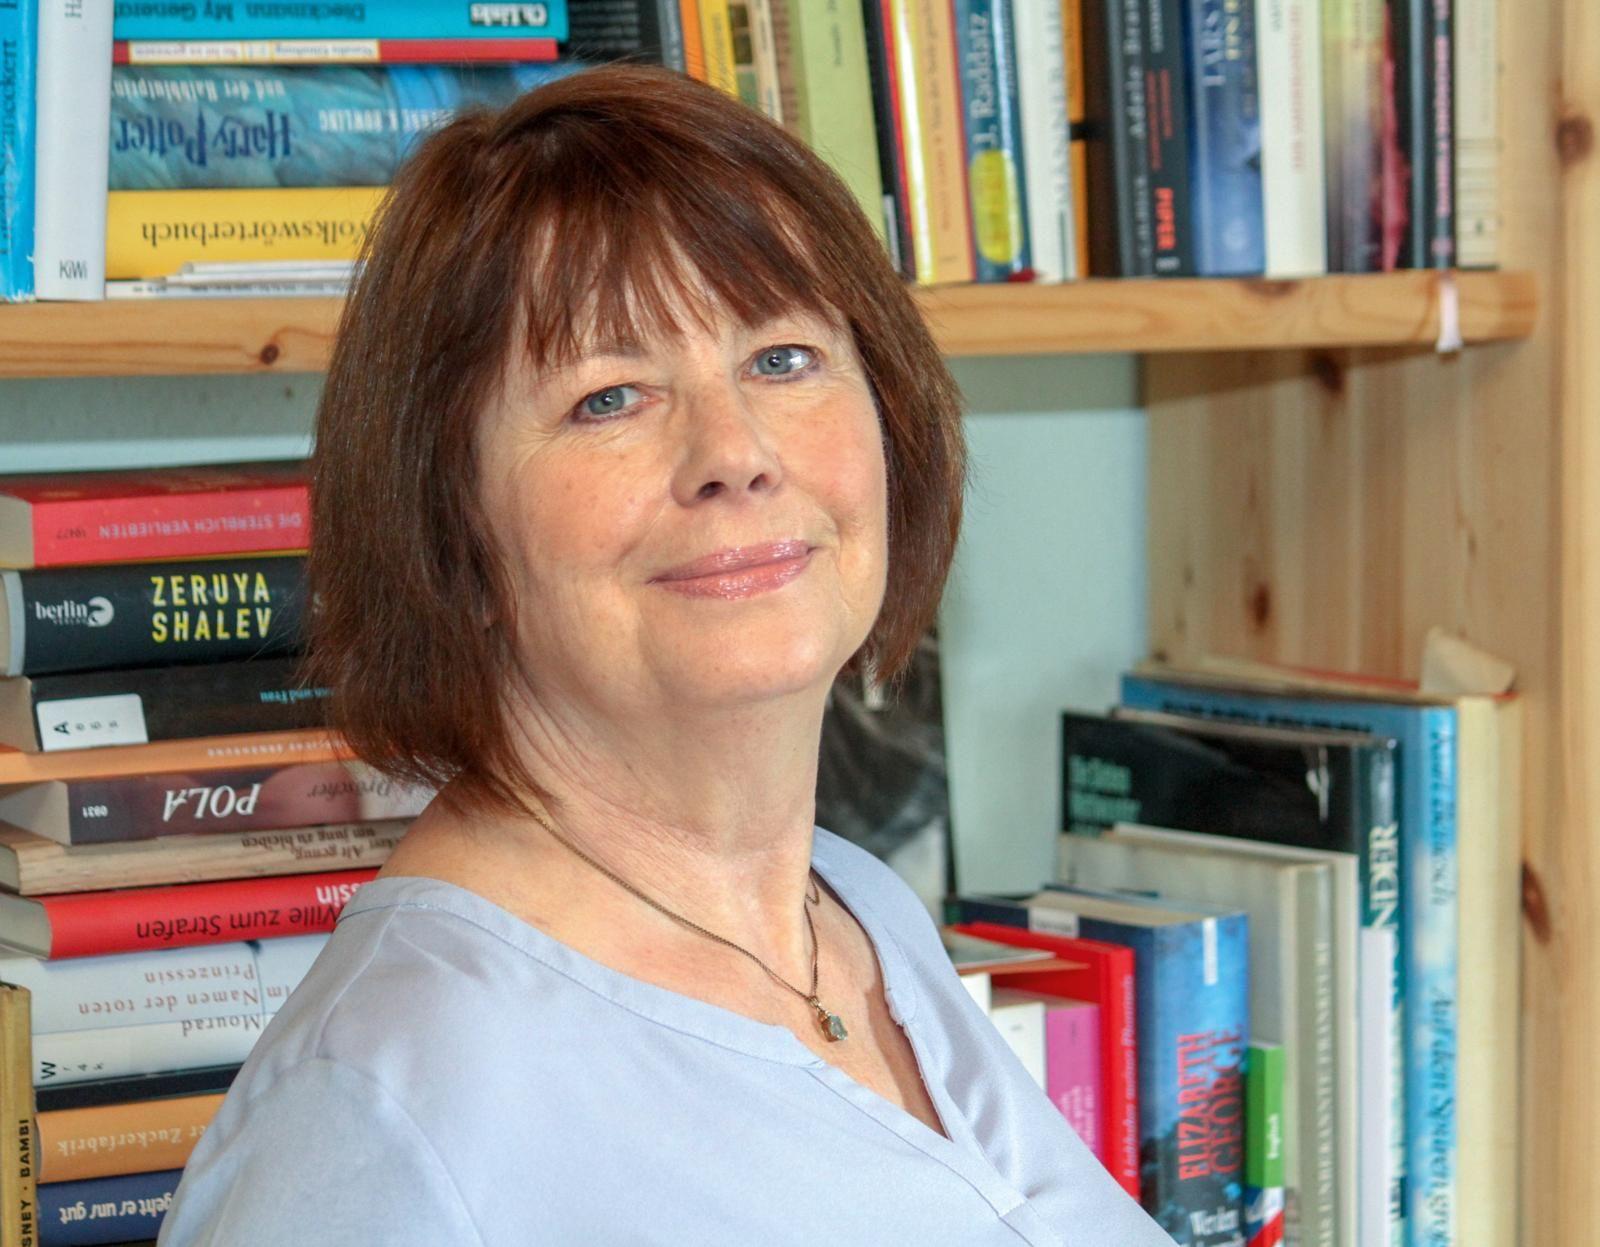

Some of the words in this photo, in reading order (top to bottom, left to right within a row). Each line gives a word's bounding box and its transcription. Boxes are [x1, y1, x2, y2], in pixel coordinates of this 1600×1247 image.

[965, 10, 995, 119] Raddatz
[223, 80, 248, 101] der
[254, 80, 286, 102] und
[319, 109, 383, 132] ROWLING
[115, 110, 208, 167] Potter
[213, 109, 291, 160] Harry
[1155, 187, 1176, 250] PIPER
[59, 260, 87, 280] KiWi
[100, 520, 196, 539] VERLIEBTEN
[200, 514, 275, 534] STERBLICH
[279, 512, 302, 529] DIE
[150, 571, 271, 608] ZERUYA
[35, 601, 87, 620] berlin
[151, 607, 273, 643] SHALEV
[260, 689, 288, 705] Frau
[53, 720, 70, 736] A
[161, 782, 262, 823] POLA
[241, 833, 293, 850] bleiben
[296, 832, 314, 844] zu
[317, 825, 348, 841] jung
[350, 826, 376, 839] um
[340, 845, 364, 860] Alt
[136, 912, 222, 940] Strafen
[229, 907, 281, 929] zum
[143, 962, 255, 985] Prinzessin
[78, 998, 136, 1017] toten
[143, 994, 178, 1013] der
[186, 987, 259, 1006] Namen
[181, 1012, 261, 1038] Mourad
[41, 1060, 57, 1080] W
[1177, 1032, 1211, 1180] ELIZABETH
[1208, 1029, 1242, 1173] GEORGE
[18, 1119, 31, 1178] BAMBI
[57, 1127, 183, 1158] Zuckerfabrik
[59, 1200, 87, 1225] gut
